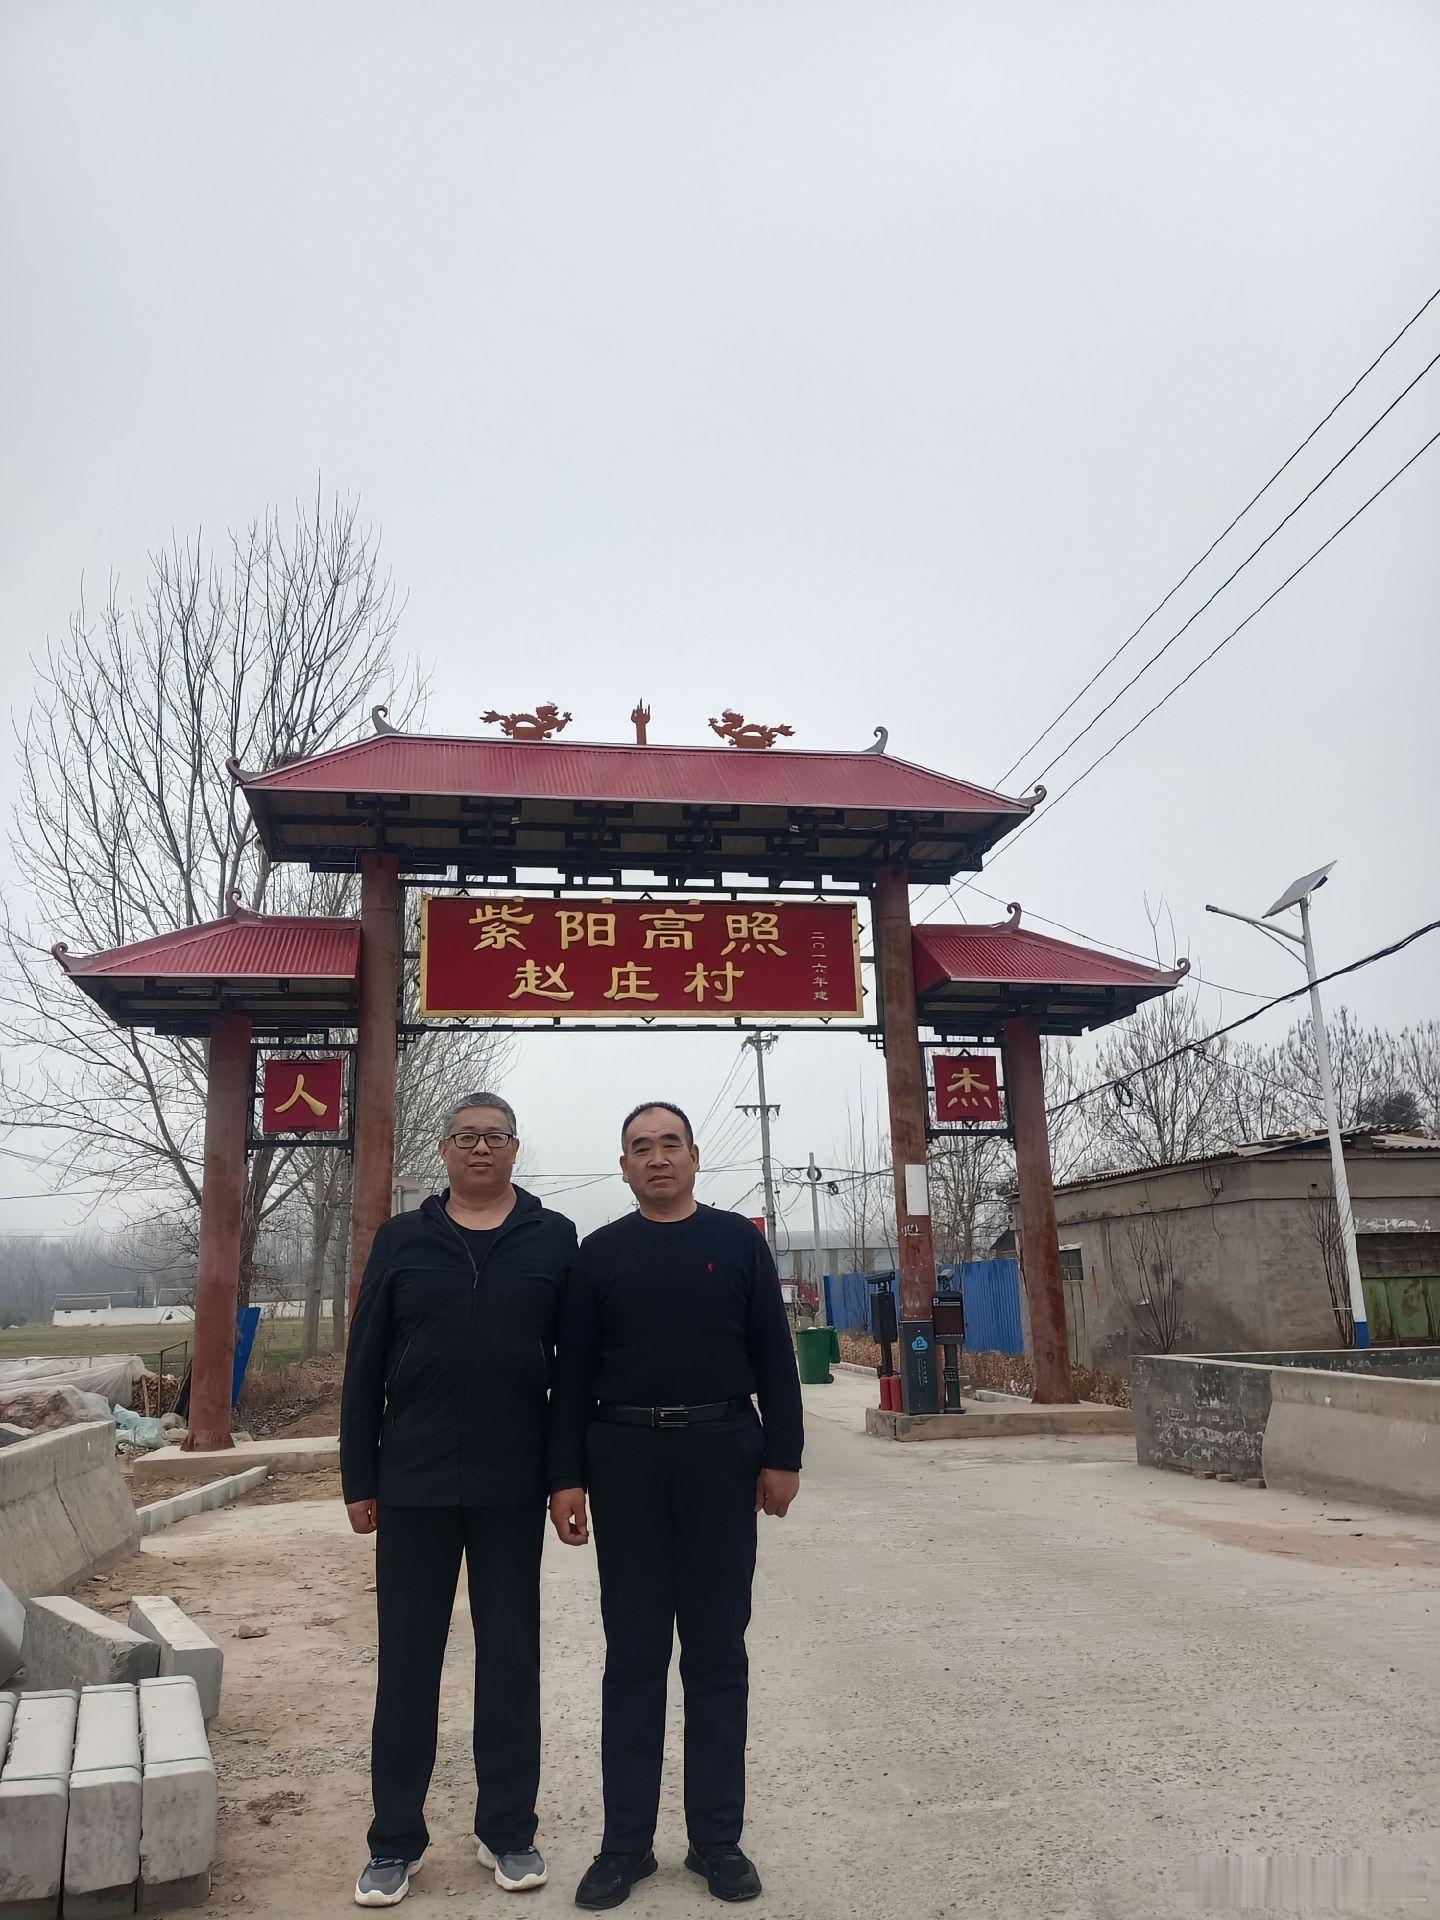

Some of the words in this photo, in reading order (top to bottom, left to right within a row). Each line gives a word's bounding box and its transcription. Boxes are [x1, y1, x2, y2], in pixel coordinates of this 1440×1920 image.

[468, 904, 787, 957] 紫阳高照
[508, 959, 745, 1003] 赵庄村
[274, 1073, 328, 1117] 人
[947, 1068, 992, 1109] 杰
